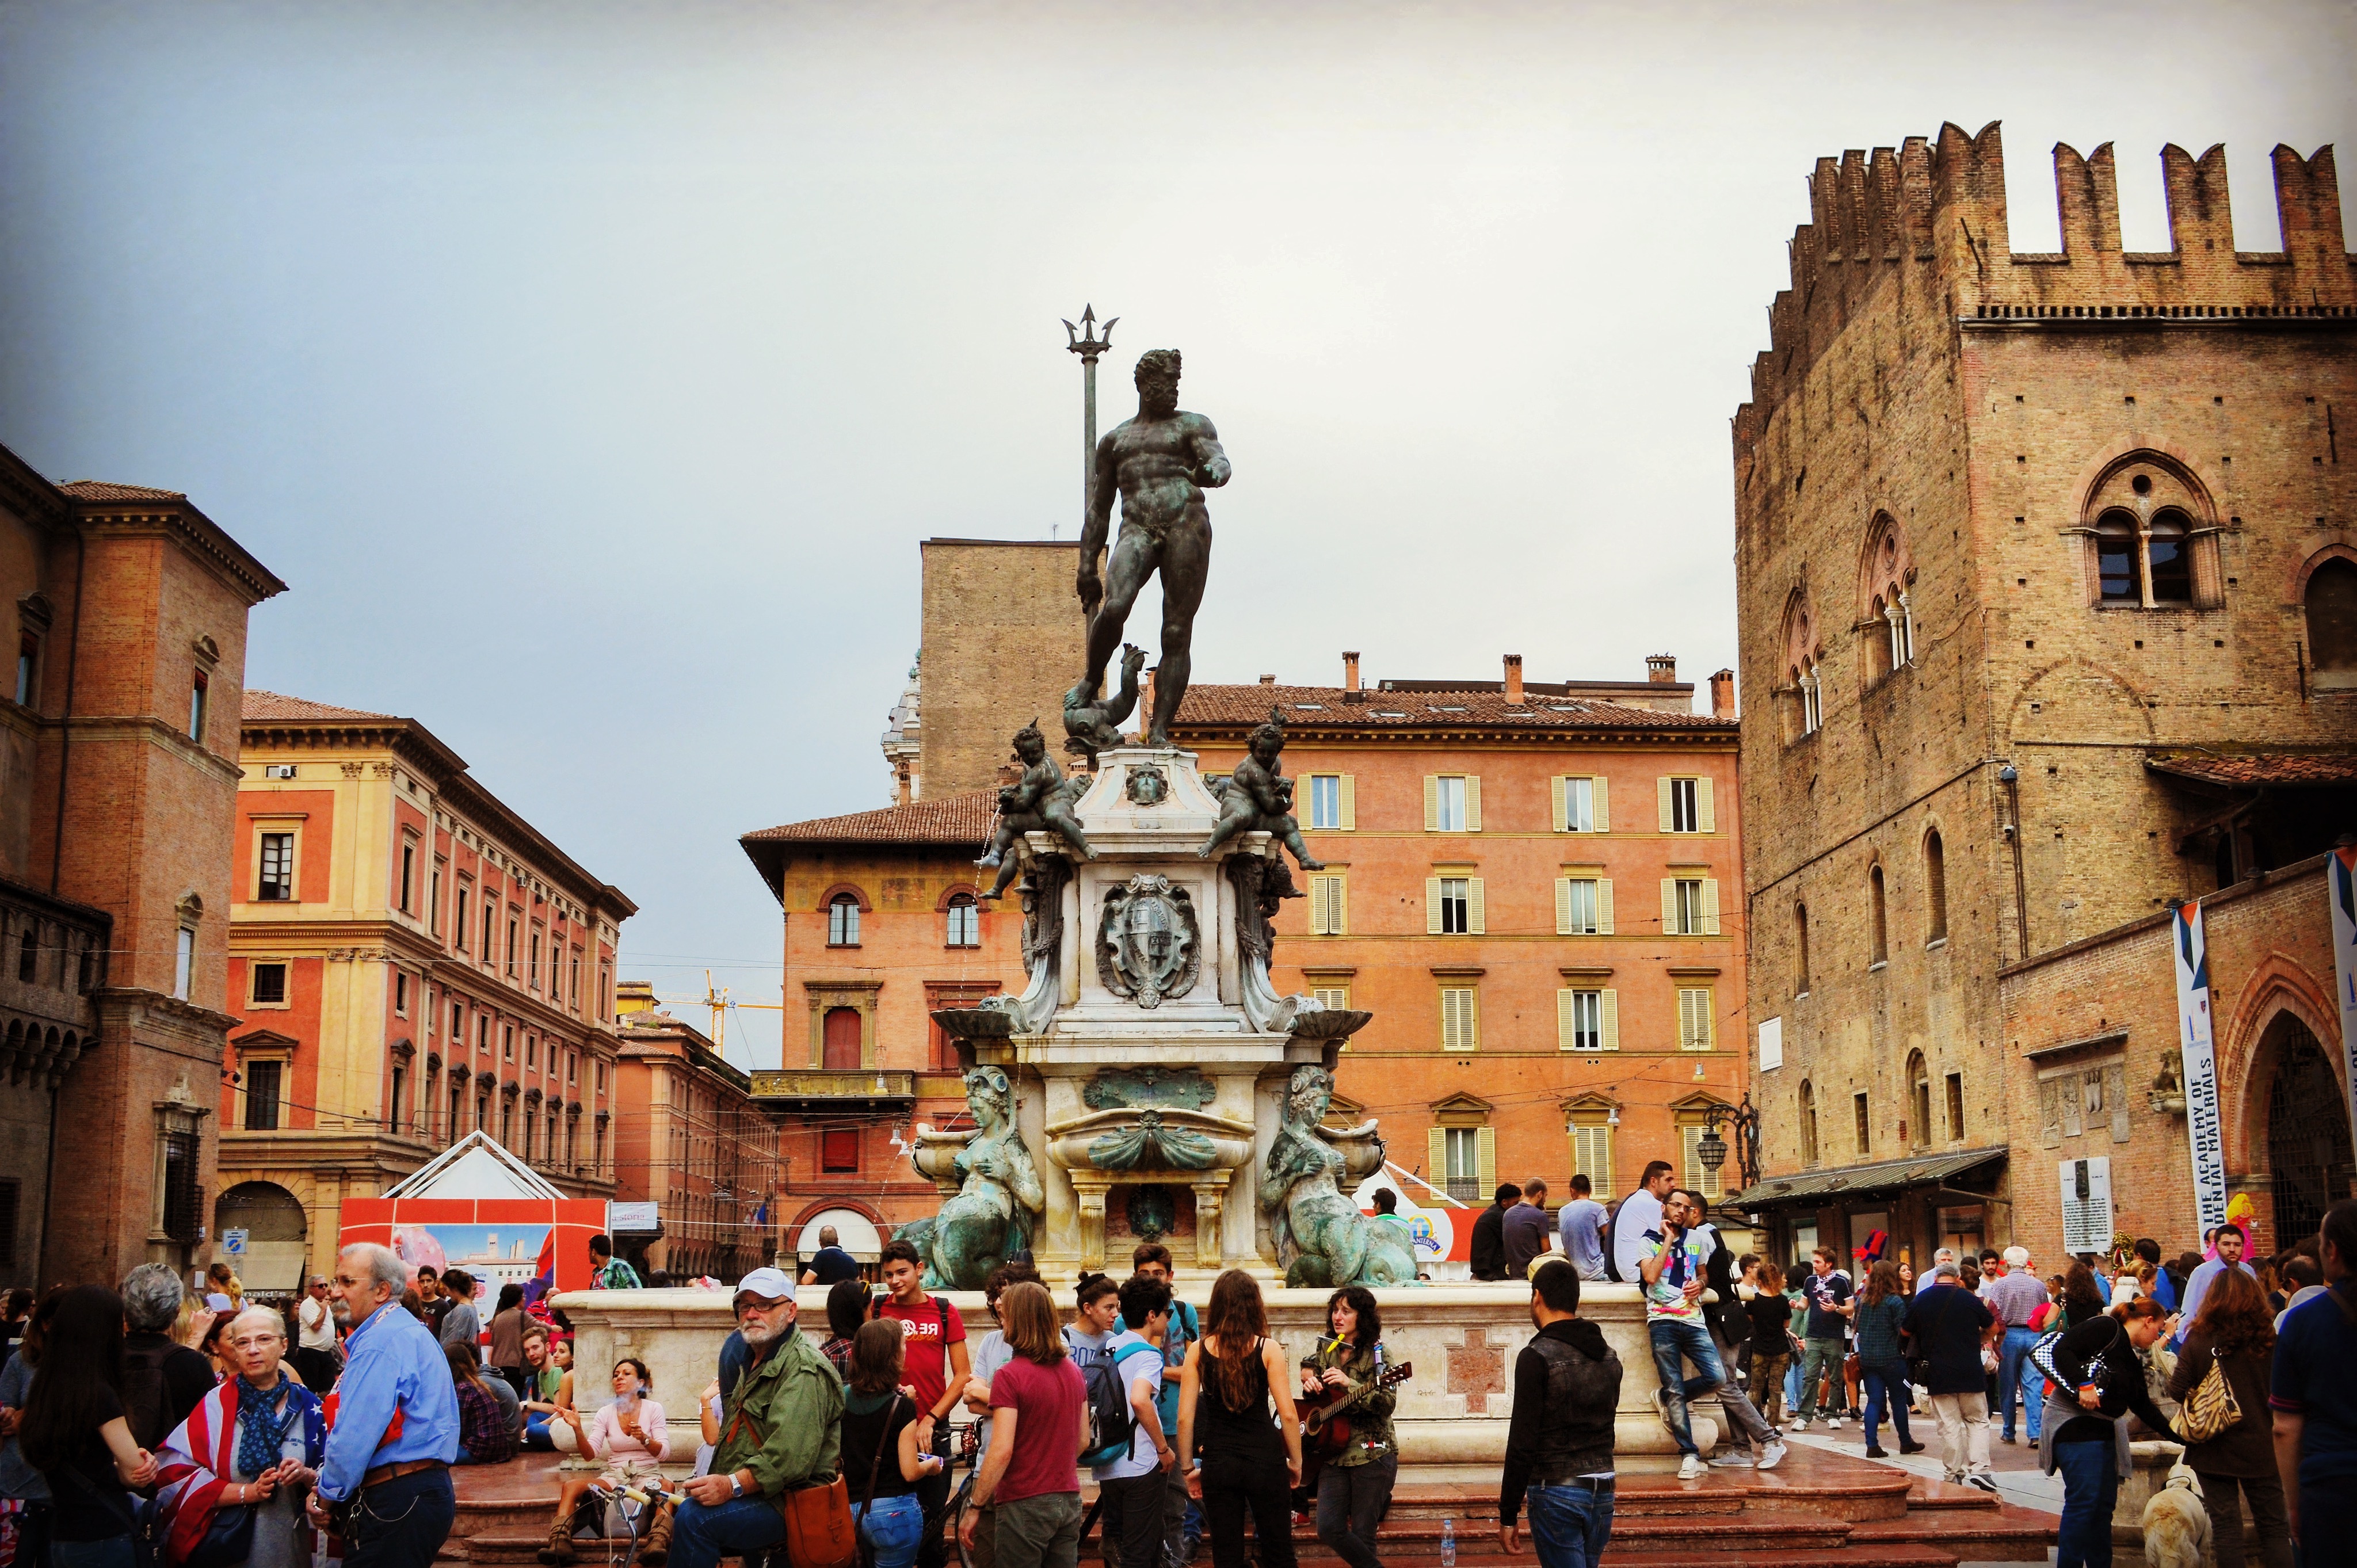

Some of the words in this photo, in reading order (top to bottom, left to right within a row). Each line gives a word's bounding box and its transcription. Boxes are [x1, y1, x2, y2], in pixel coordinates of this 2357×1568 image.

[2190, 1078, 2202, 1098] OF
[2200, 1058, 2218, 1151] MATERIALS
[2193, 1107, 2210, 1185] ACADEMY
[2210, 1159, 2225, 1224] DENTAL
[620, 1212, 644, 1221] storia
[2201, 1193, 2213, 1225] THE
[906, 1333, 937, 1341] ctors
